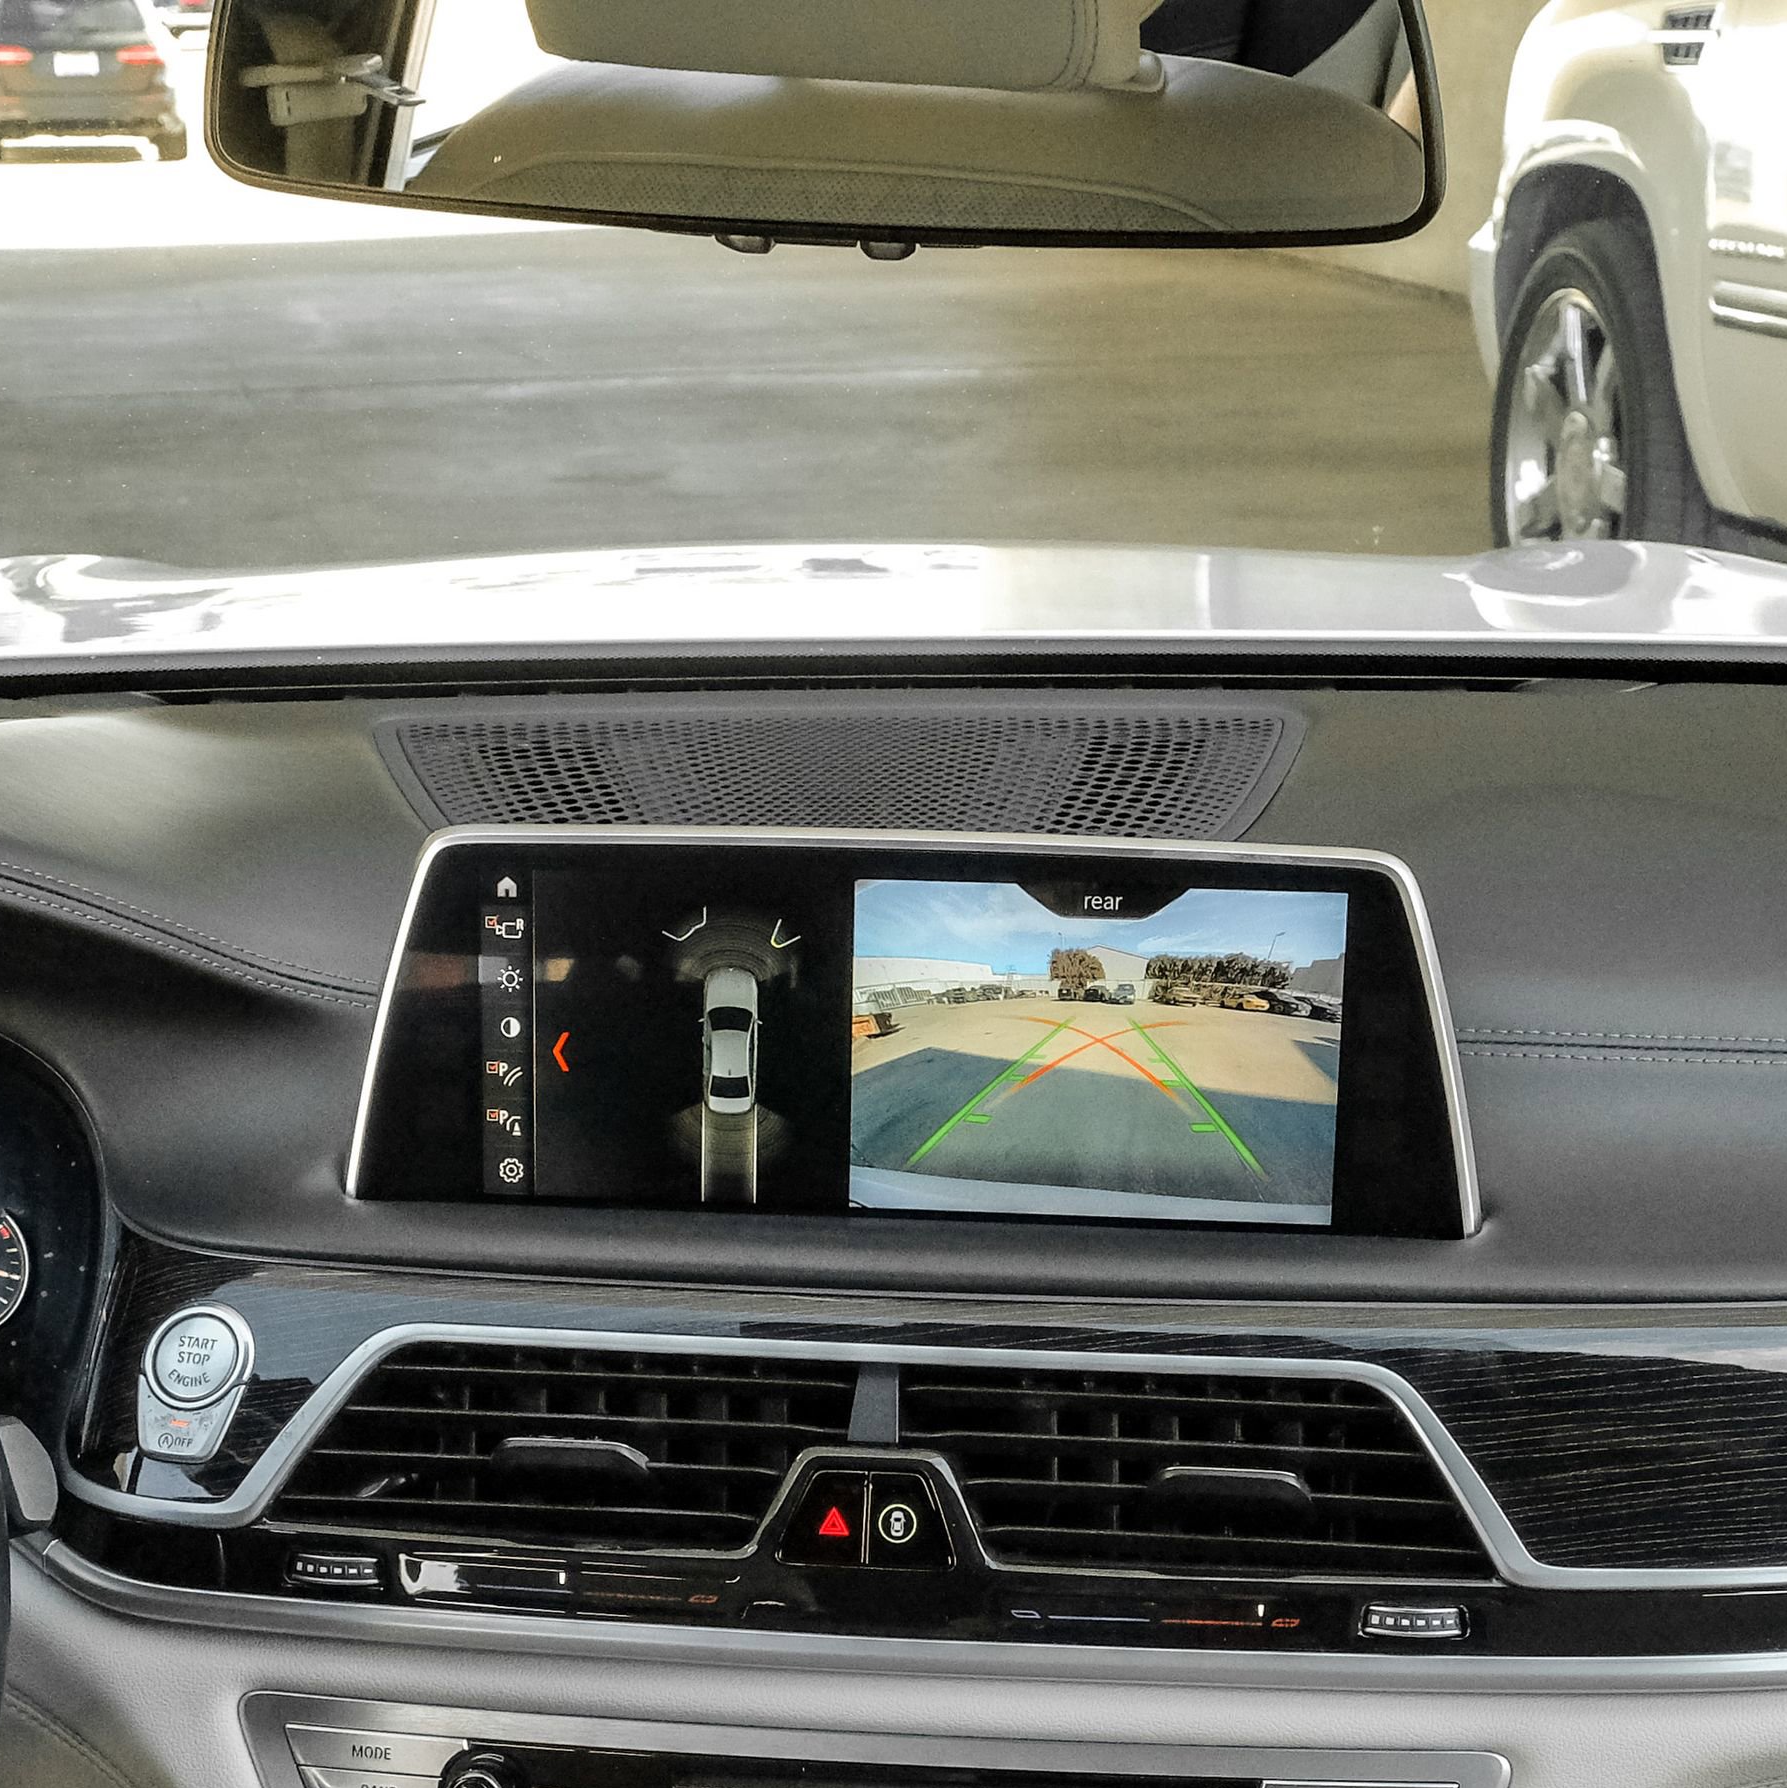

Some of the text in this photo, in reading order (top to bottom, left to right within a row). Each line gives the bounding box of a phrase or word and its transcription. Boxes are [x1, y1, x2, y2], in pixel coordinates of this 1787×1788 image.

[1083, 895, 1124, 911] rear
[178, 1335, 218, 1351] START
[176, 1351, 211, 1366] STOP
[167, 1368, 212, 1388] ENGINE
[174, 1436, 194, 1449] OFF
[351, 1744, 392, 1761] MODE
